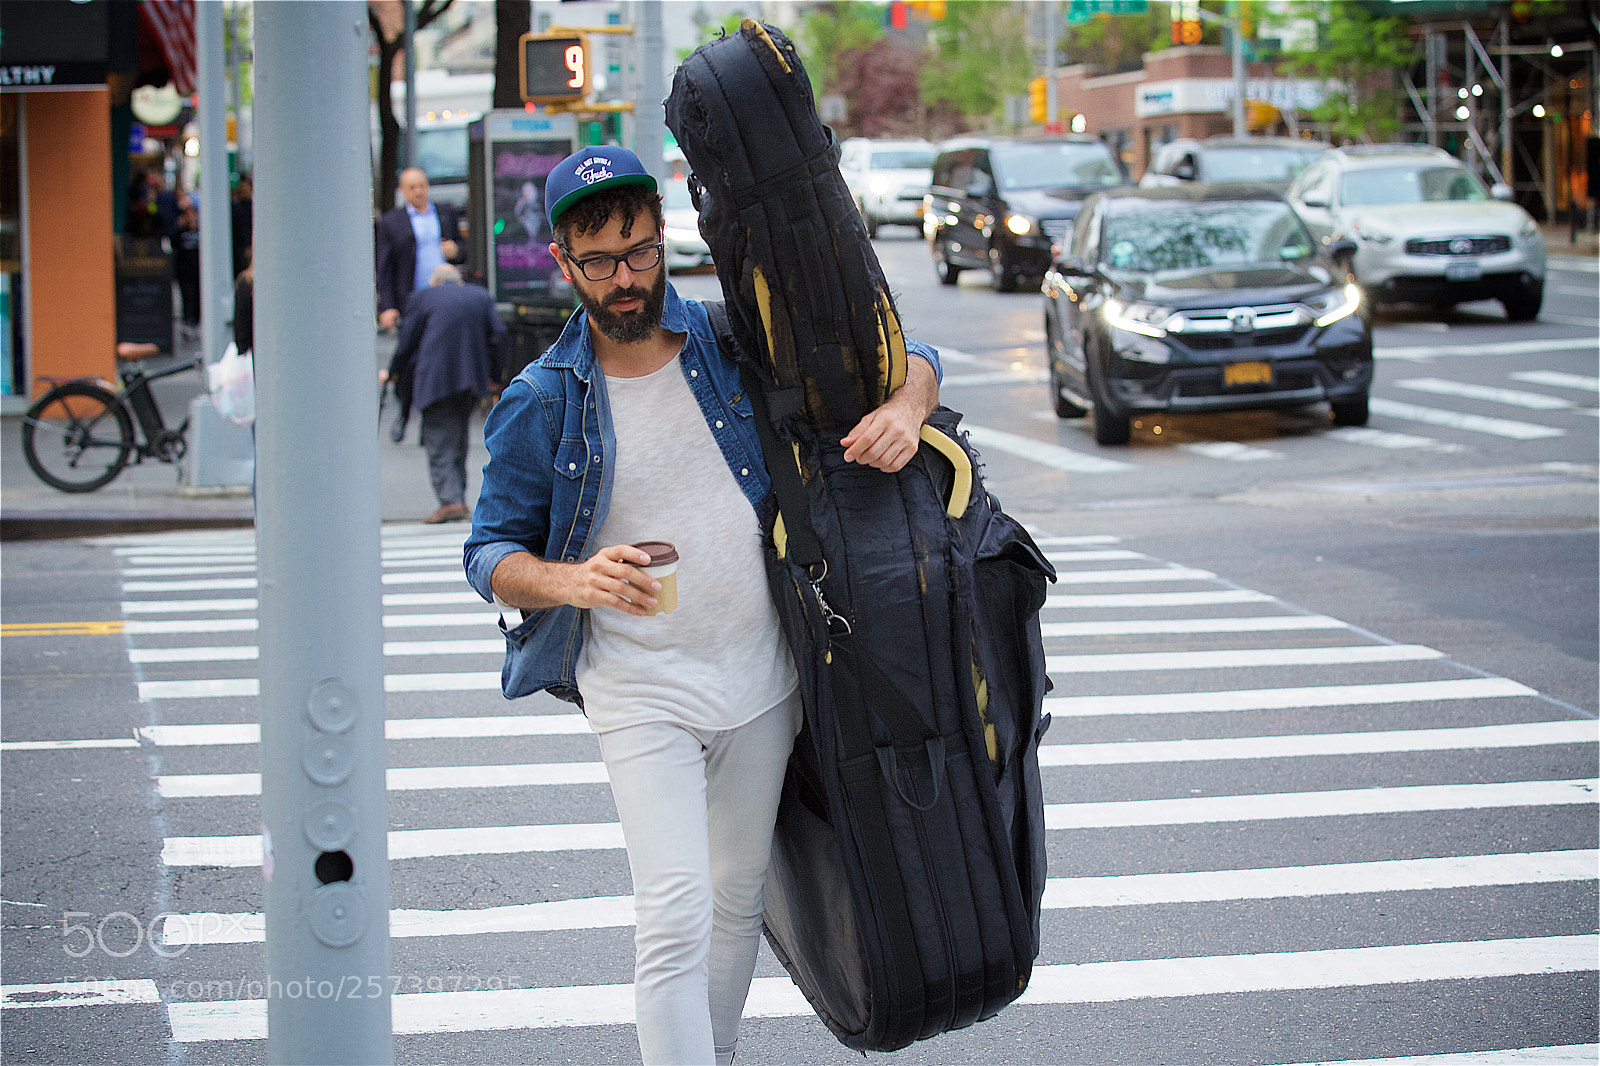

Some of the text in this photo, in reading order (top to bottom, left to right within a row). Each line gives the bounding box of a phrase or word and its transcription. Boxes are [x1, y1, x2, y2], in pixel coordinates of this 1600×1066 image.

[564, 44, 585, 89] 9
[583, 157, 594, 167] NOT
[581, 166, 613, 185] Fuck
